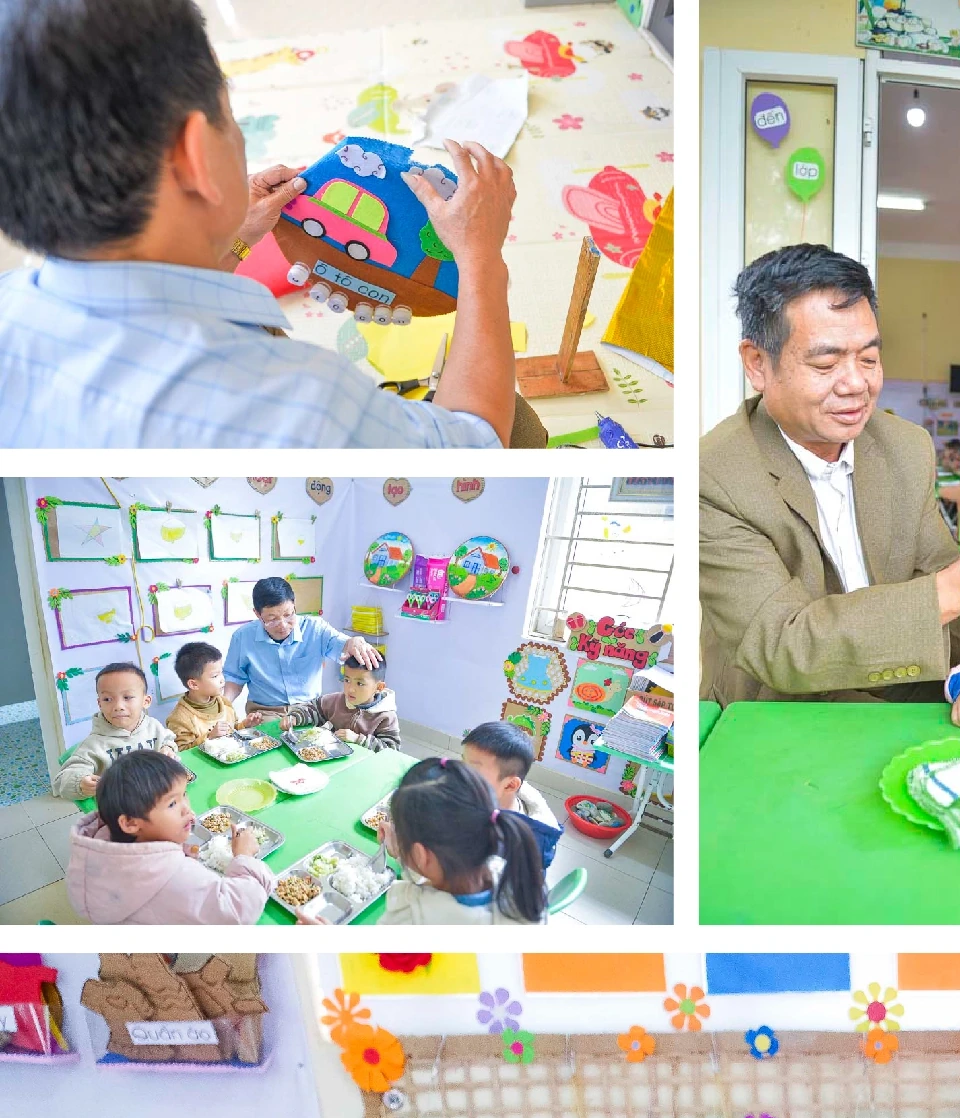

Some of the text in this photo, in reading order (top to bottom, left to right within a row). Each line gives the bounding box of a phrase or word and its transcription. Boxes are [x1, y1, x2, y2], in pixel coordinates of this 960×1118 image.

[357, 285, 391, 304] con
[310, 480, 331, 495] động
[596, 616, 635, 640] Góc
[602, 642, 650, 670] năng
